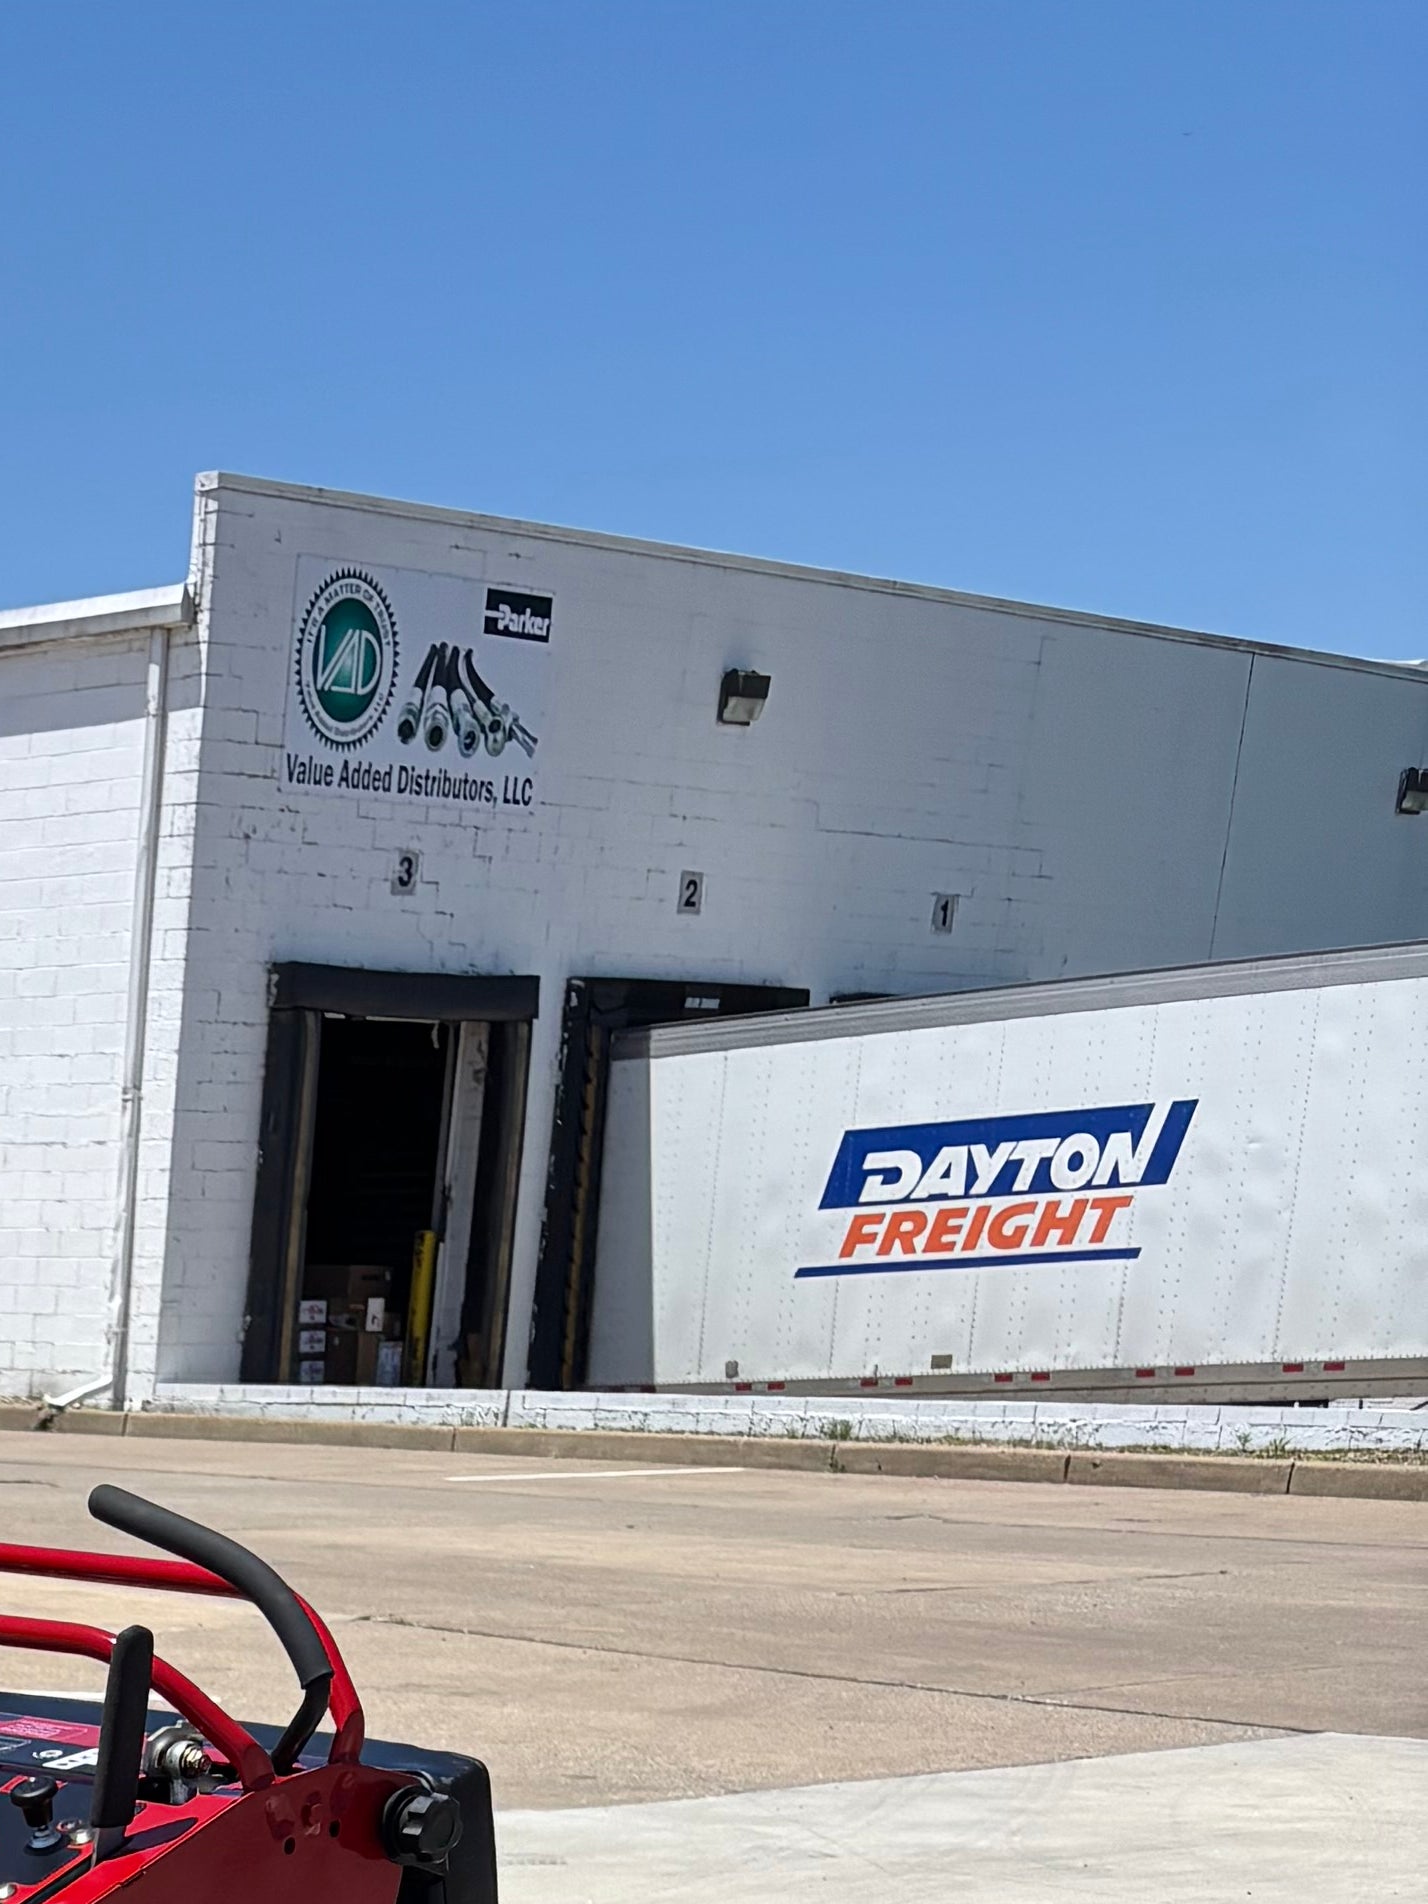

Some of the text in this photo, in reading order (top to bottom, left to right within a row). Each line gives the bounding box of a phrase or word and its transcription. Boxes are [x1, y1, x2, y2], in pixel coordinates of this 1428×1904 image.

[497, 603, 550, 636] Parker
[286, 753, 534, 807] Value Added Distributors, LLC
[398, 856, 414, 885] 3
[683, 879, 700, 908] 2
[939, 903, 950, 928] 1
[857, 1131, 1154, 1203] DAYTON
[839, 1195, 1134, 1259] FREIGHT
